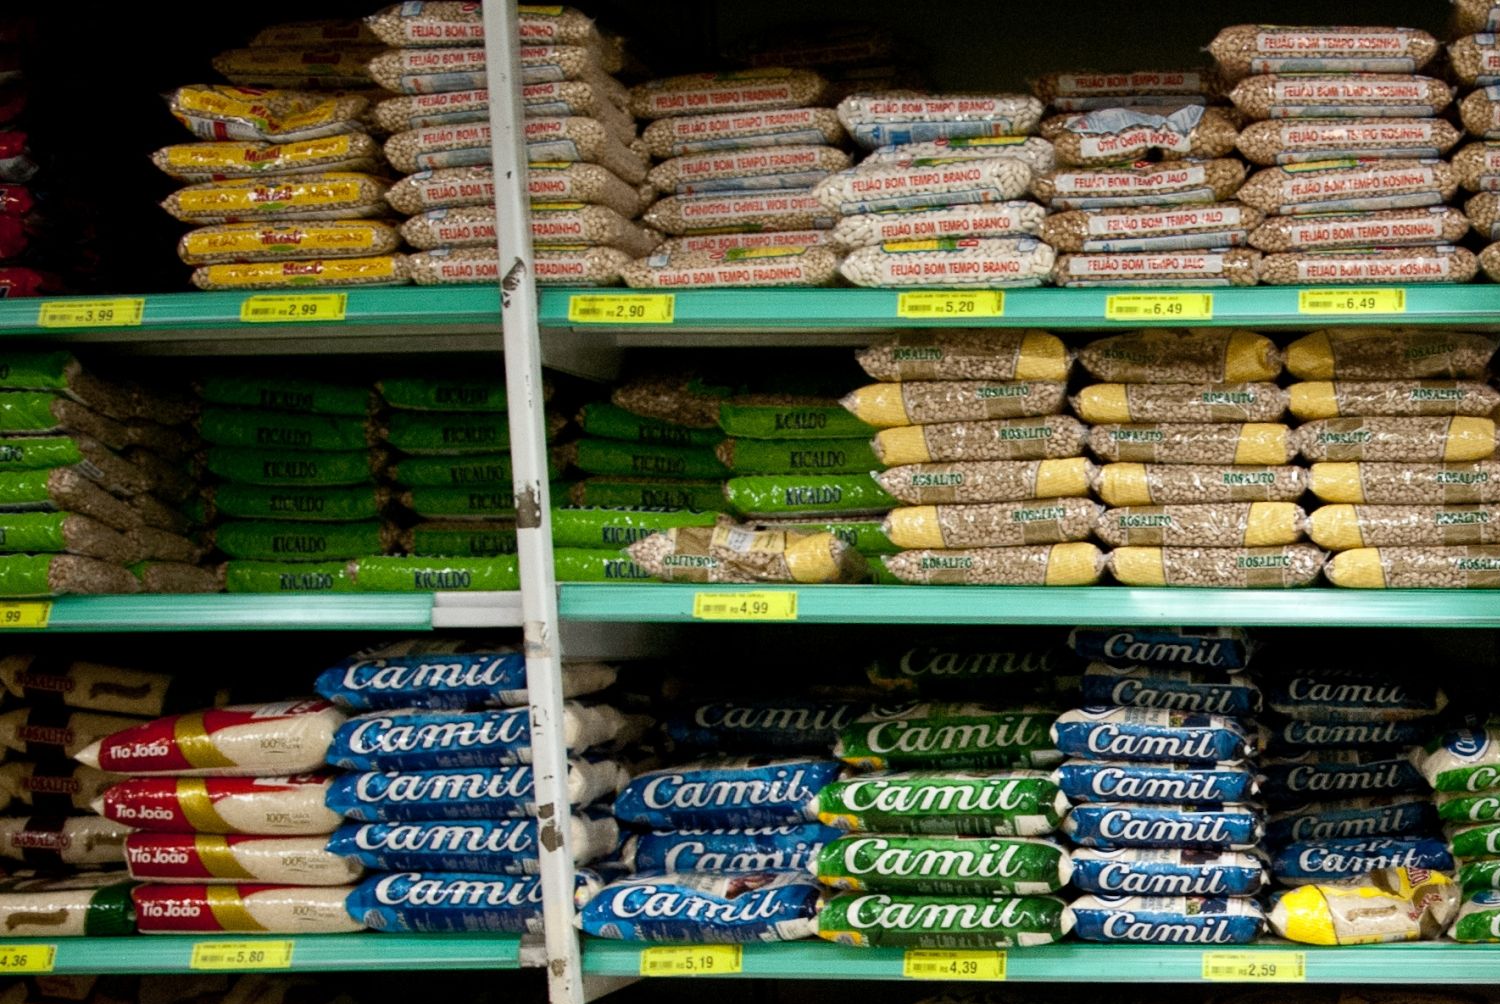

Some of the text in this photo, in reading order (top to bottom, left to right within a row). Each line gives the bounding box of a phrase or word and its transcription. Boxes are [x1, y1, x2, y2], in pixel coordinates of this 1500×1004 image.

[884, 177, 906, 189] BOM
[909, 173, 939, 187] TEMPO
[943, 169, 981, 183] BRANCO
[1332, 228, 1354, 240] BOM
[1358, 226, 1389, 238] TEMPO
[1392, 224, 1434, 236] ROSINHA
[692, 271, 716, 284] BOM
[718, 270, 750, 282] TEMPO
[753, 267, 801, 280] FRADINHO
[924, 263, 946, 274] BOM
[949, 262, 980, 273] TEMPO
[983, 260, 1020, 272] BRANCO
[1203, 391, 1255, 404] ROSALITO
[1001, 426, 1053, 440] ROSALITO
[790, 450, 846, 468] KICALDO
[912, 473, 964, 486] ROSALITO
[1224, 472, 1275, 484] ROSALITO
[786, 486, 843, 505] KICALDO
[1118, 515, 1172, 527] ROSALITO
[1237, 555, 1290, 568] ROSALITO
[415, 570, 471, 589] KICALDO
[1104, 633, 1223, 666] Camil
[343, 657, 506, 690] Camil
[350, 713, 525, 754] Camil
[867, 717, 1038, 754] Camil
[1088, 724, 1219, 758] Camil
[111, 743, 169, 760] Tio João
[643, 770, 808, 811] Camil
[843, 779, 1022, 812] Camil
[115, 804, 174, 821] Tio João
[355, 820, 532, 852] Camil
[1100, 862, 1228, 895] Camil
[611, 886, 784, 923] Camil
[847, 895, 1027, 930] Camil
